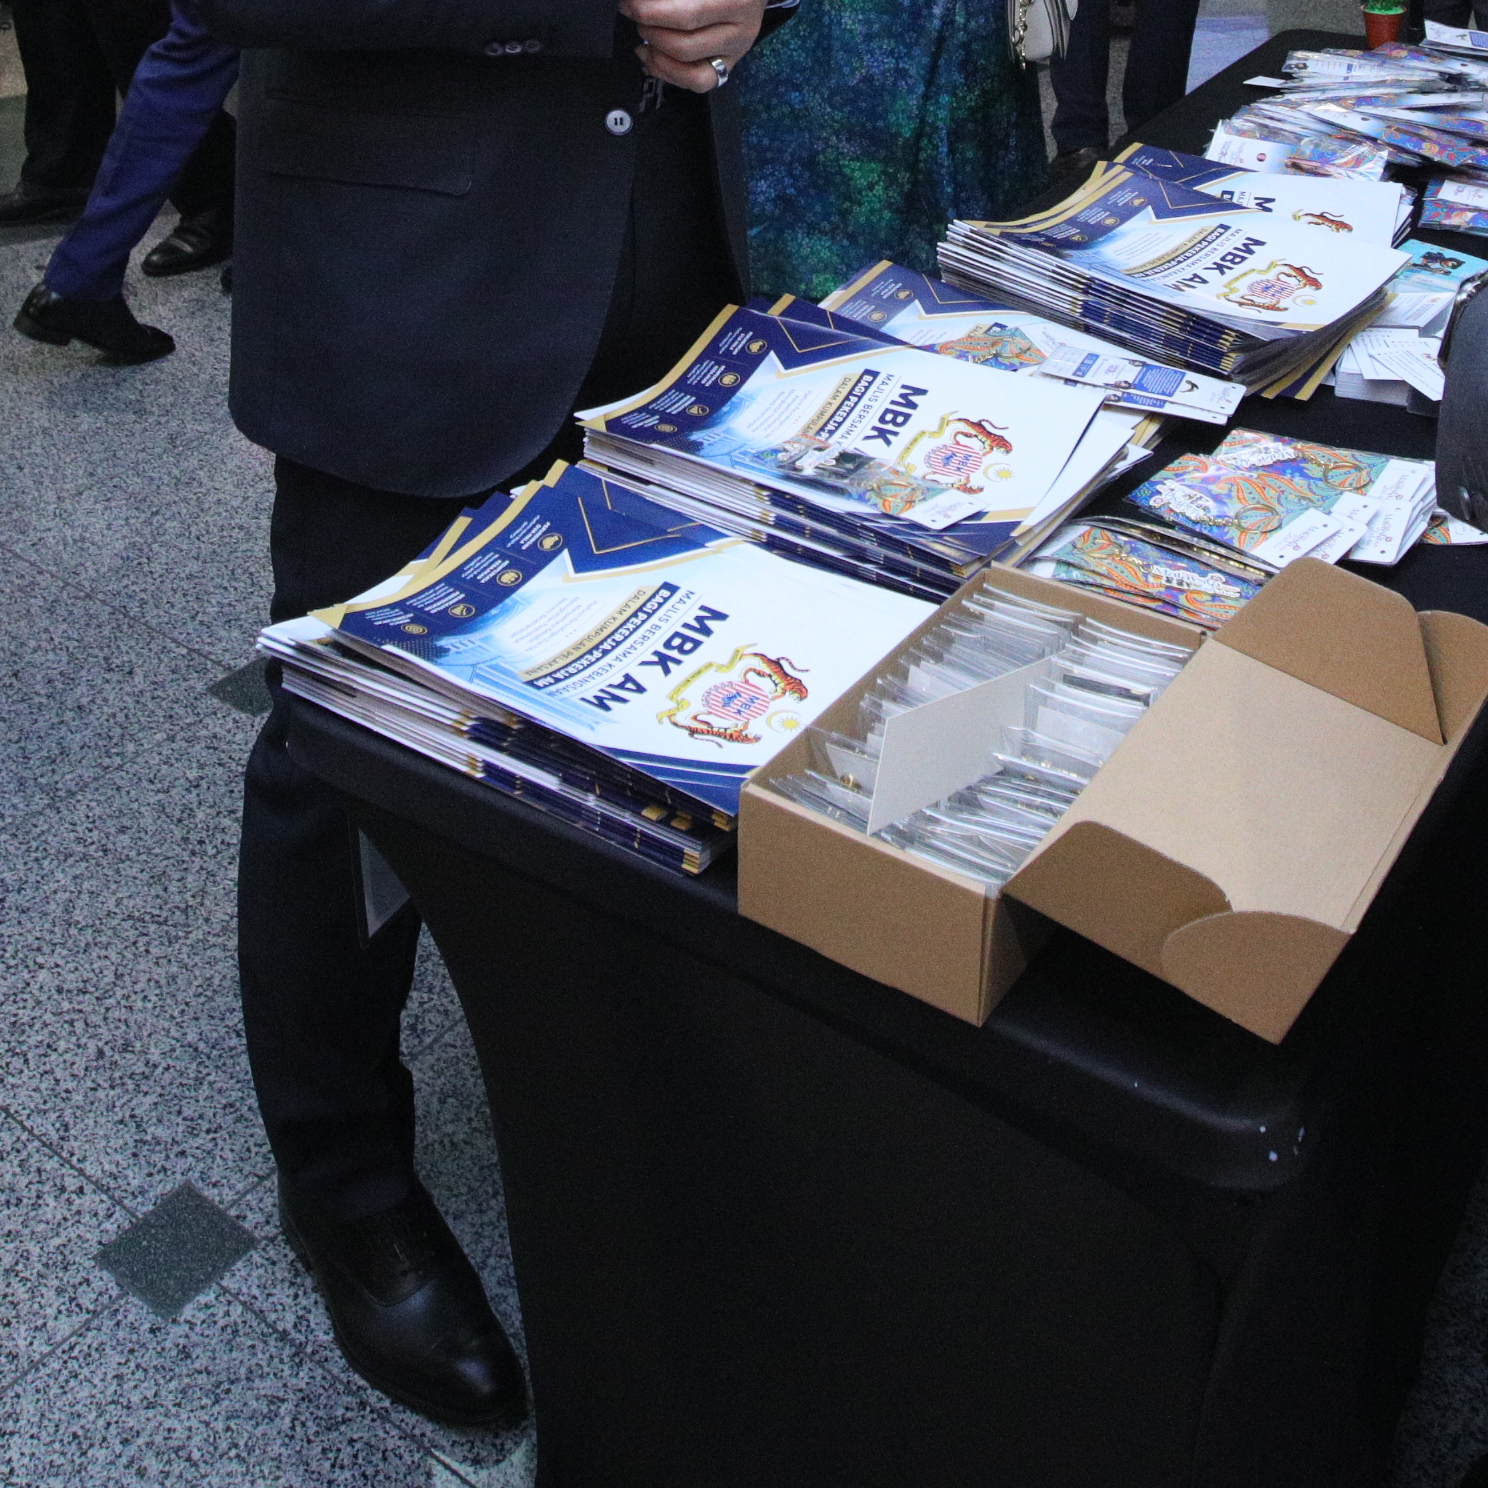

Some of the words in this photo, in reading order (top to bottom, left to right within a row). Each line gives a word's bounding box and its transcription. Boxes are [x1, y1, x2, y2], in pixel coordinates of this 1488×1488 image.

[1204, 236, 1267, 276] MBK
[1164, 272, 1210, 293] AM
[827, 376, 853, 403] DALAM
[851, 373, 874, 398] BAGI
[868, 373, 896, 403] MAJLIS
[816, 396, 859, 441] PEKERJA-P
[840, 402, 873, 441] BERSAMA
[862, 383, 929, 448] MBK
[614, 589, 647, 615] DALAM
[640, 589, 672, 613] BAGI
[656, 590, 696, 623] MAJLIS
[555, 611, 649, 679] PEKERJA-PEKERJA
[570, 616, 619, 651] KUMPULAN
[611, 623, 662, 662] BERSAMA
[638, 604, 730, 677] MBK
[524, 651, 575, 677] PELAKSANA
[531, 675, 557, 688] AM
[578, 672, 648, 712] AM
[734, 694, 761, 717] MBK
